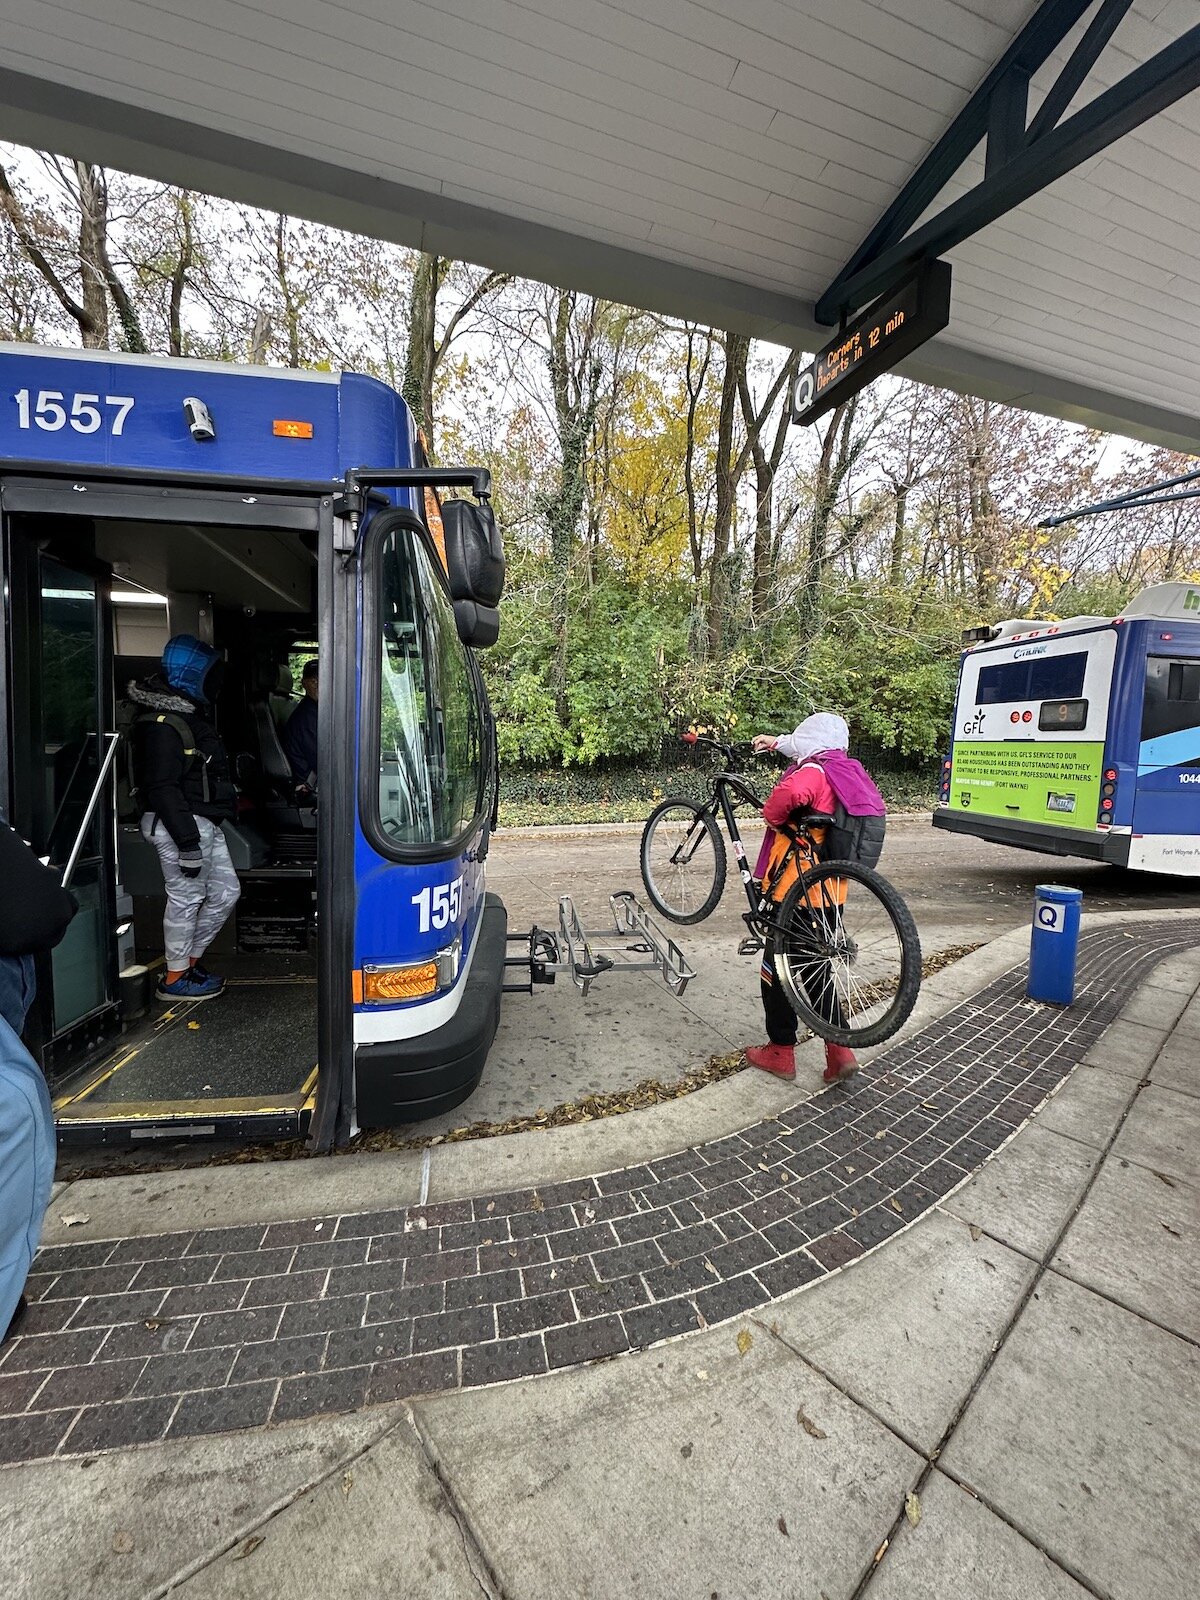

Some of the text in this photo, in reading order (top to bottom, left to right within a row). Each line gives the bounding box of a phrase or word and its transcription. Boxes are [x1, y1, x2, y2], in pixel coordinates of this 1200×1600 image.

[817, 311, 904, 392] Departs in 12 min
[795, 372, 814, 412] Q
[14, 388, 135, 436] 1557
[1058, 704, 1068, 722] 9
[963, 715, 985, 735] GFL
[1020, 770, 1059, 780] PROFESSIONAL
[1021, 761, 1059, 770] OUTSTANDING
[1074, 763, 1091, 771] THEY
[1009, 782, 1029, 790] WAYNE)
[1174, 848, 1193, 857] Wayne
[1038, 905, 1057, 928] Q
